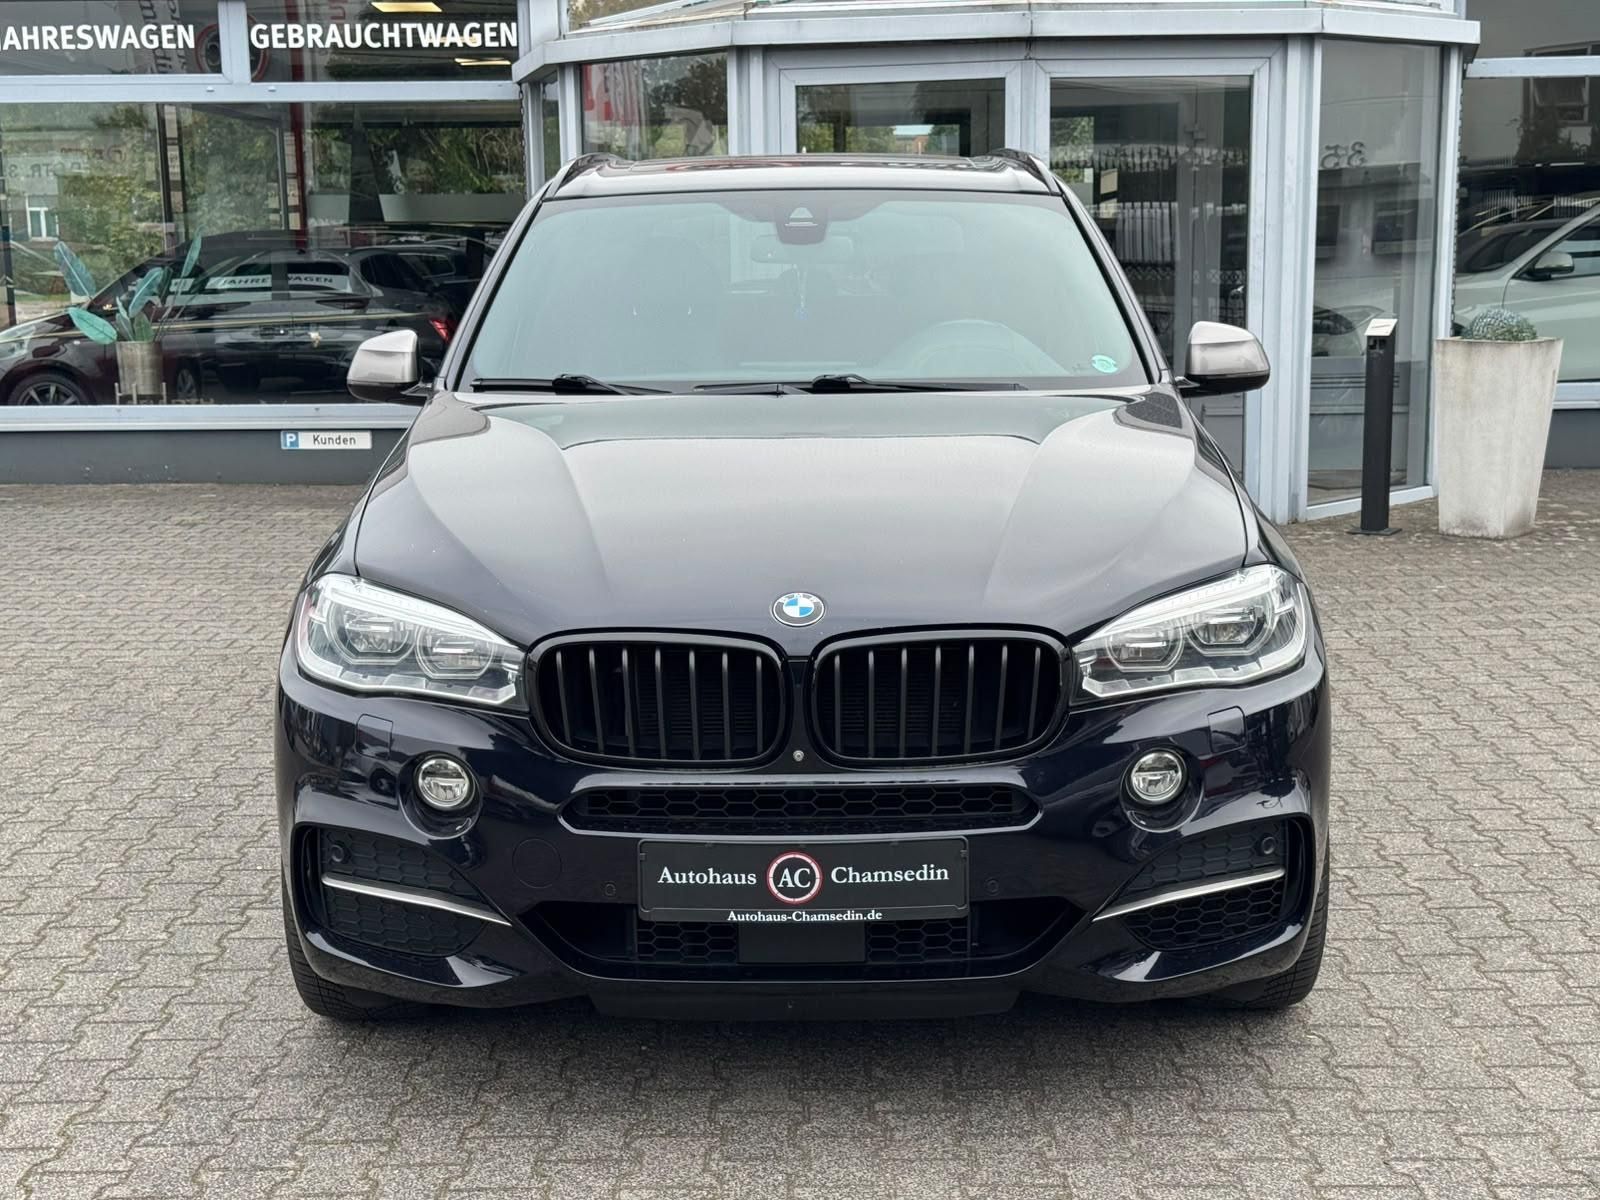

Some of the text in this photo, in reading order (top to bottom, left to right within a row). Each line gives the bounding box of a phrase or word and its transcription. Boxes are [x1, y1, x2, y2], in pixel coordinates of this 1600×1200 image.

[0, 24, 196, 51] AHRESWAGEN
[250, 21, 518, 49] GEBRAUCHTWAGEN
[286, 433, 356, 447] P Kunden
[657, 863, 950, 889] Autohaus AC Chamsedin
[727, 910, 883, 922] Autohaus-Chamsedin.de
